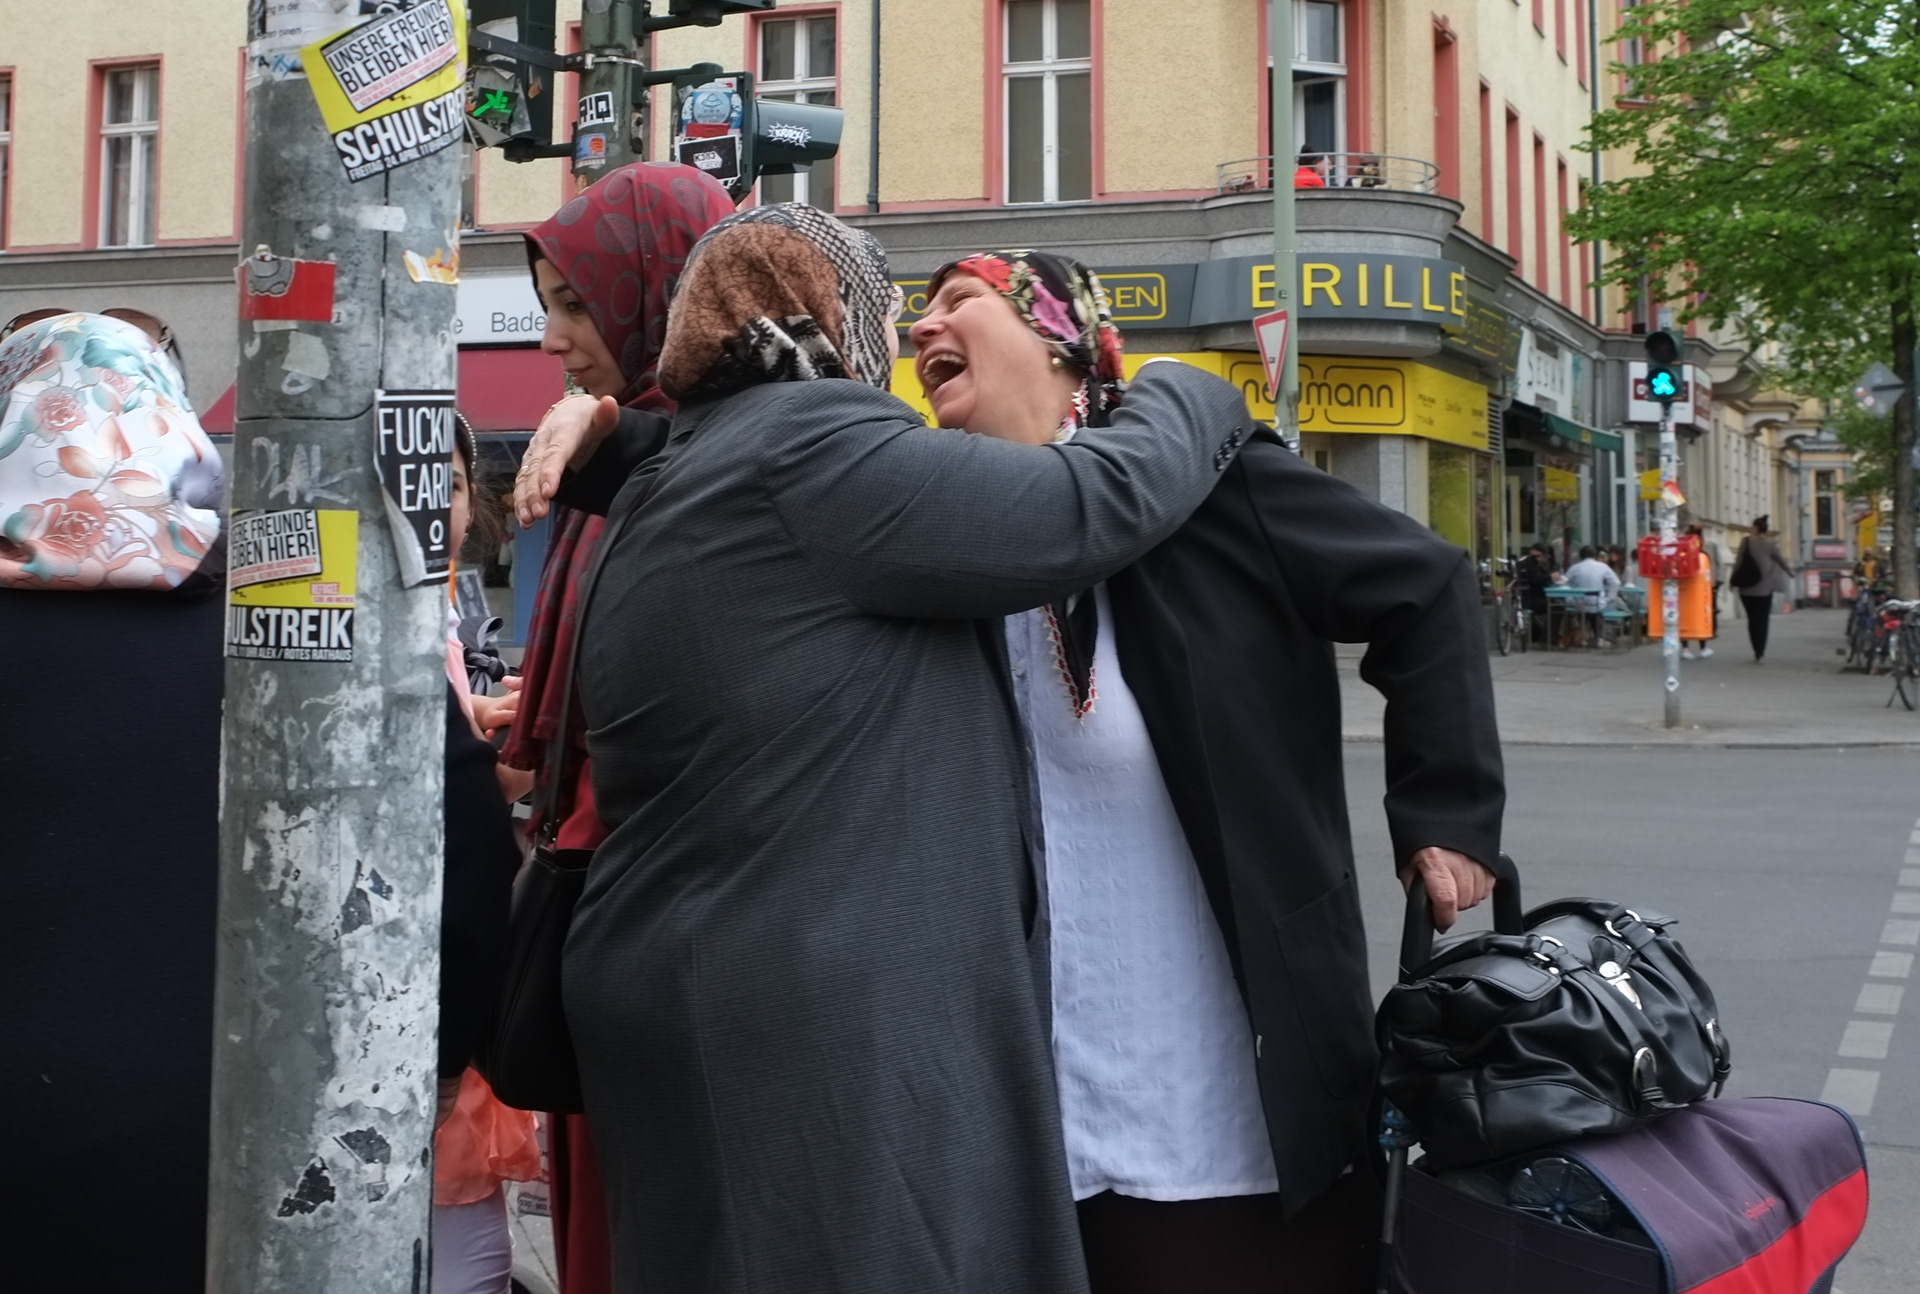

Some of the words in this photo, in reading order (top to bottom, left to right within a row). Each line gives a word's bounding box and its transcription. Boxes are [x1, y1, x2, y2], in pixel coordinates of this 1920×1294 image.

[328, 28, 388, 73] UNSERE
[389, 0, 449, 41] FREUNDE
[340, 42, 418, 93] BLEIBEN
[415, 18, 452, 56] HIER
[1243, 378, 1394, 409] nemann
[251, 510, 315, 539] FREUNDE
[267, 531, 317, 561] HIER!
[230, 606, 353, 648] ULSTREIK
[284, 649, 311, 660] ROTES
[312, 650, 352, 661] RATHAUS
